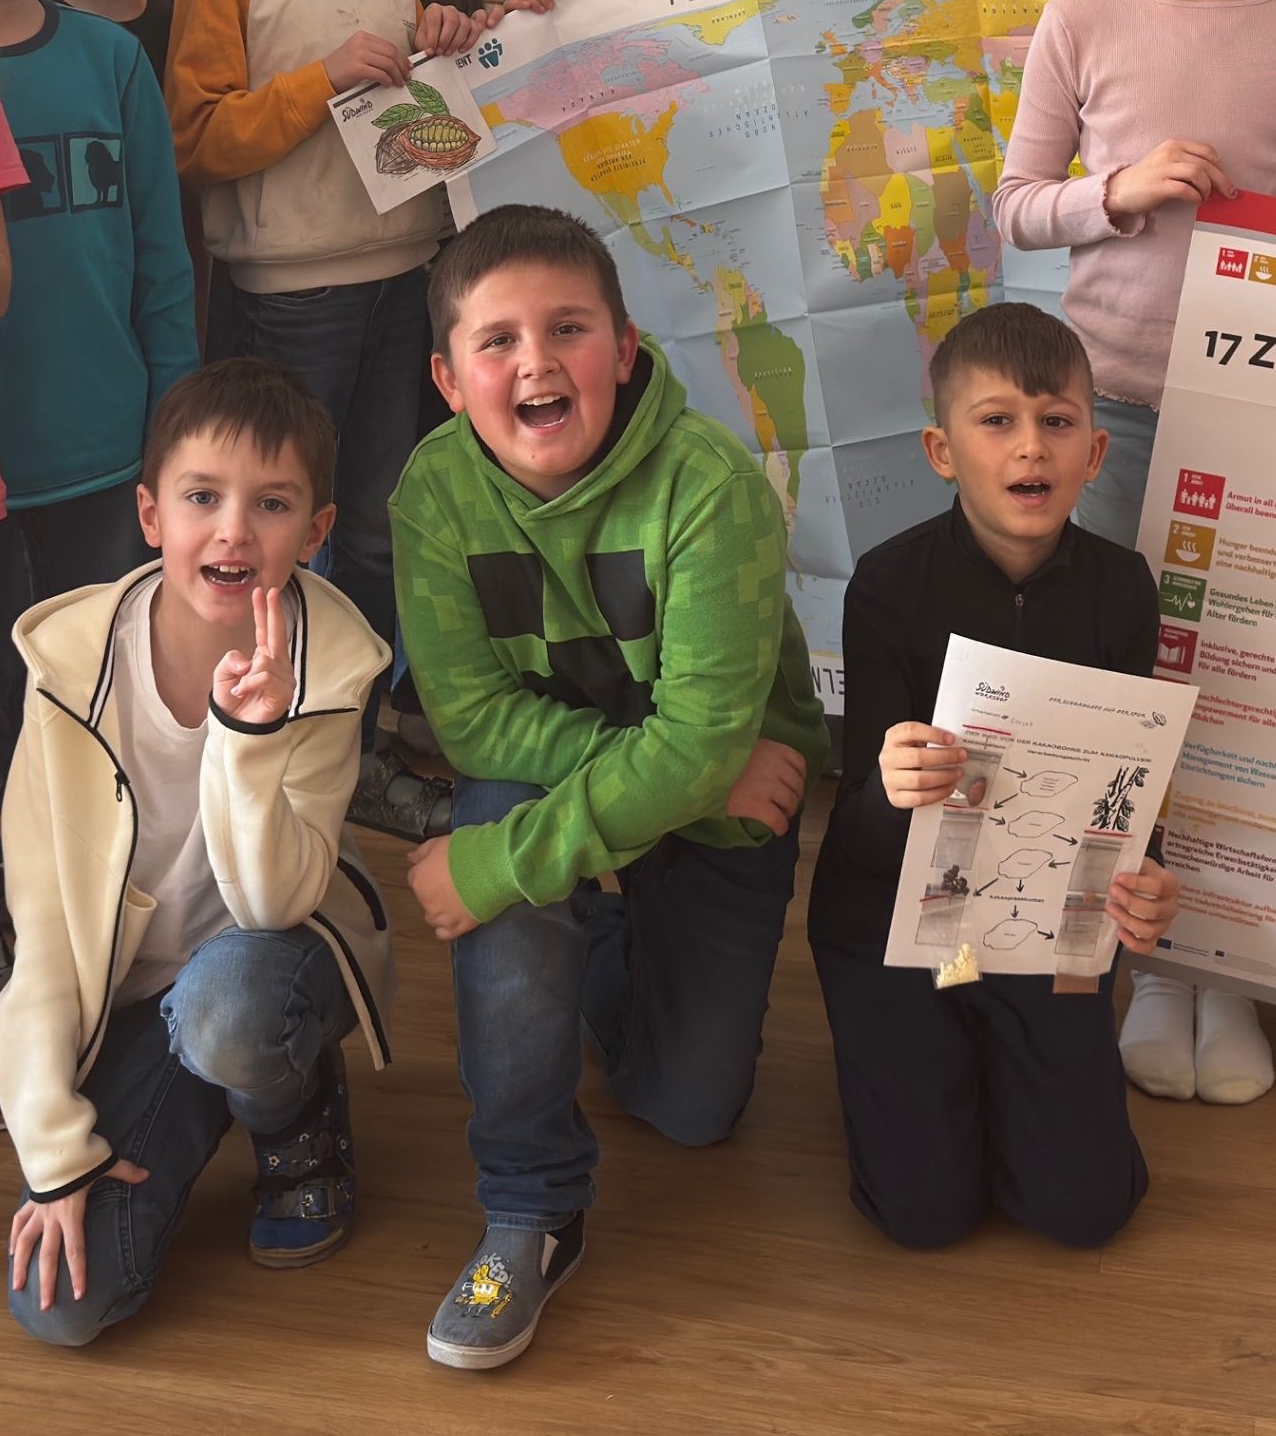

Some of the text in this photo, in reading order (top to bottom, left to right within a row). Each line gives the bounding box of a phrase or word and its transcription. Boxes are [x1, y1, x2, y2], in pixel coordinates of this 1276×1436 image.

[1204, 330, 1242, 365] 17
[1225, 501, 1253, 514] überall
[1226, 491, 1252, 503] Armut
[1253, 496, 1262, 504] in
[1262, 498, 1273, 507] all
[1207, 597, 1260, 614] Wohlergehen
[1260, 608, 1274, 618] für
[1209, 587, 1248, 602] Gesundes
[1248, 596, 1274, 607] Leben
[1205, 609, 1257, 626] Alter fördern
[1198, 649, 1230, 666] Bildung
[1231, 658, 1260, 670] sichern
[1260, 666, 1276, 674] und
[1200, 639, 1238, 655] Inklusive,
[1238, 650, 1275, 663] gerechte
[1197, 660, 1256, 681] für alle fördern
